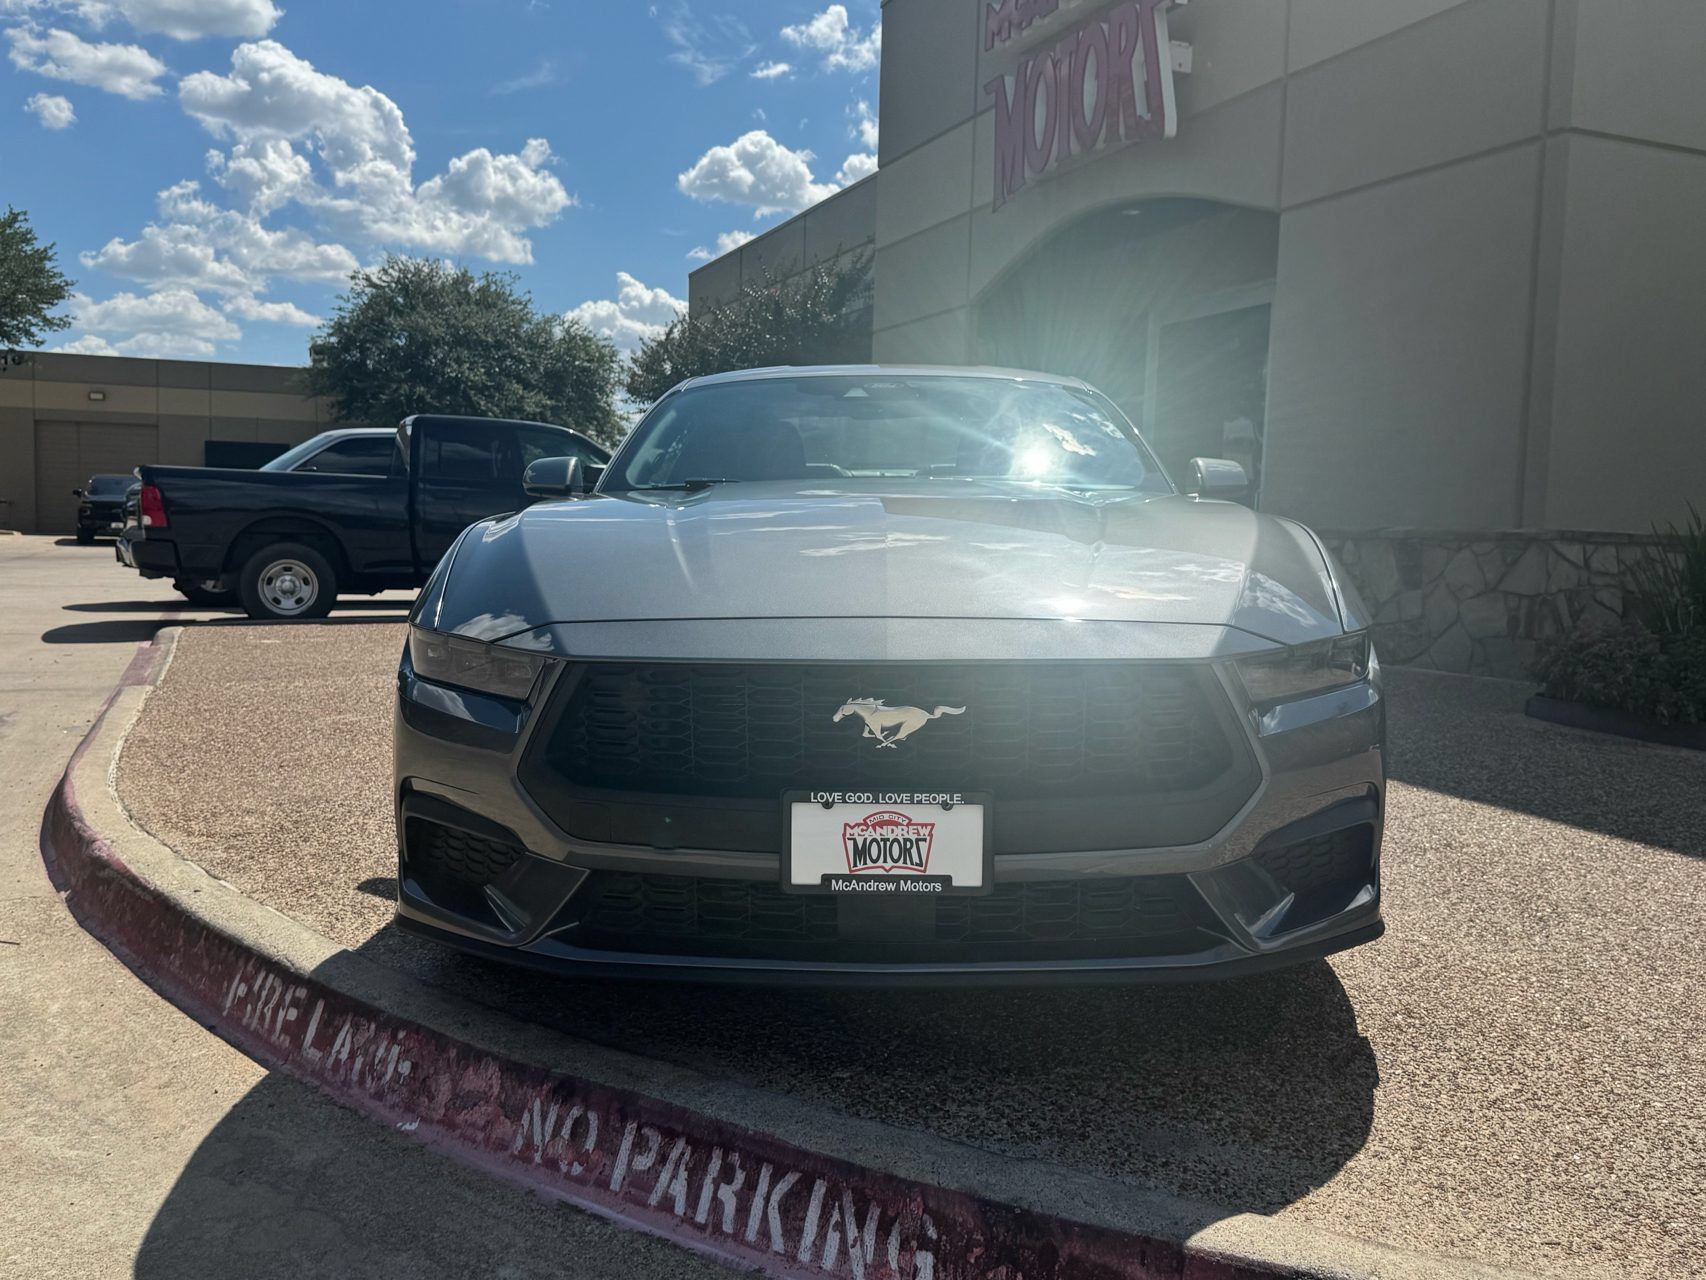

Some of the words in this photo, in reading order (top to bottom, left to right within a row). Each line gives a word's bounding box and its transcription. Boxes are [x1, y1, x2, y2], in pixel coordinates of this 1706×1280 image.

[810, 792, 842, 803] LOVE
[845, 792, 876, 804] GOD.
[879, 793, 911, 804] LOVE
[913, 794, 965, 805] PEOPLE.
[868, 814, 885, 824] MID
[888, 814, 907, 824] CITY
[847, 837, 928, 868] MOTORS
[831, 879, 897, 892] McAndrew
[900, 880, 942, 892] Motors
[513, 1097, 599, 1177] NO
